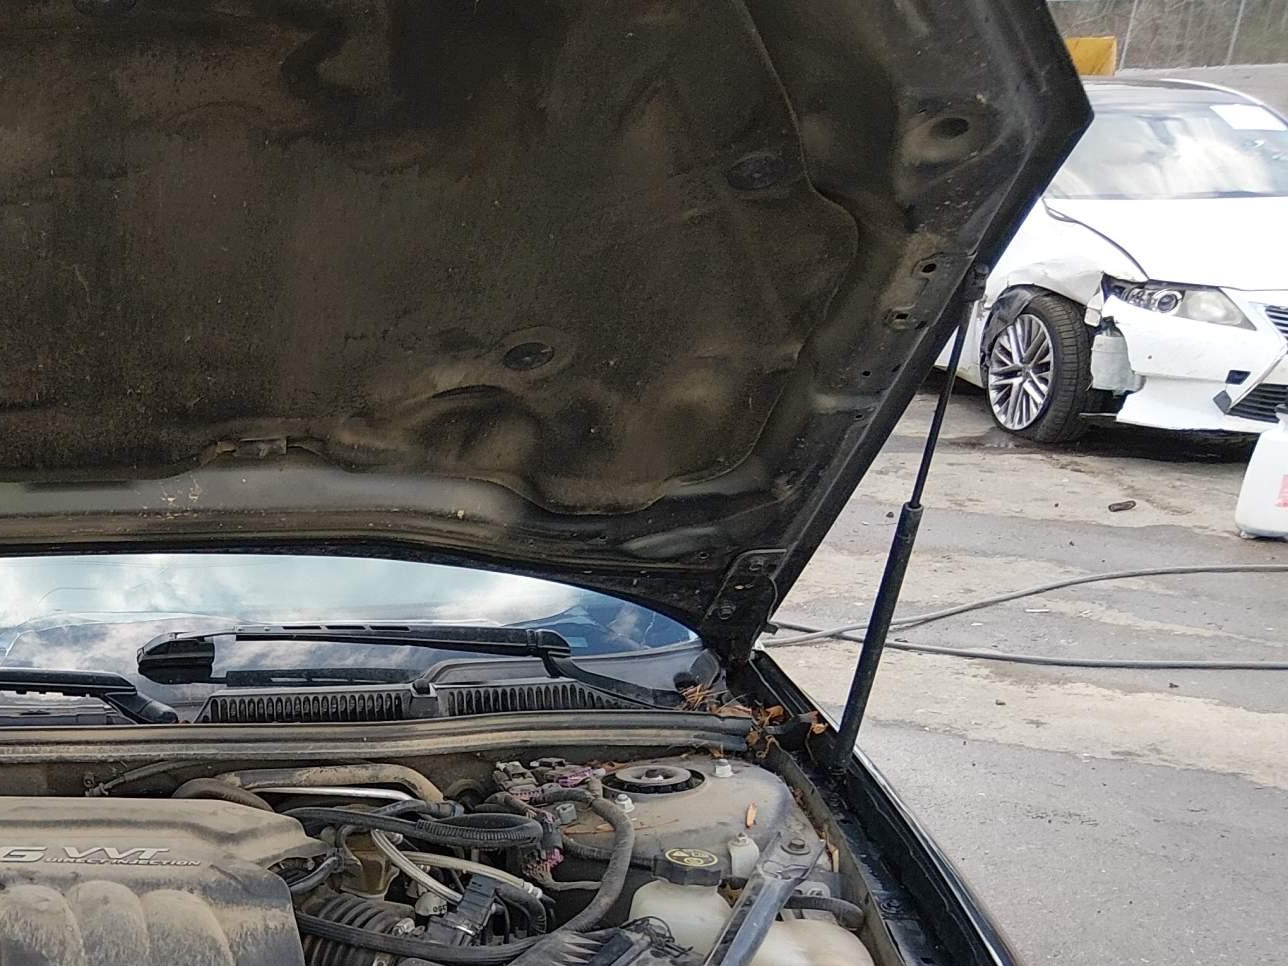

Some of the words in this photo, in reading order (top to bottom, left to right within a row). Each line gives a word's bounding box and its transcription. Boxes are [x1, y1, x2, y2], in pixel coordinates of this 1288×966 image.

[62, 847, 170, 860] VVT
[44, 857, 110, 865] DIRECT
[111, 858, 201, 866] INJECTION
